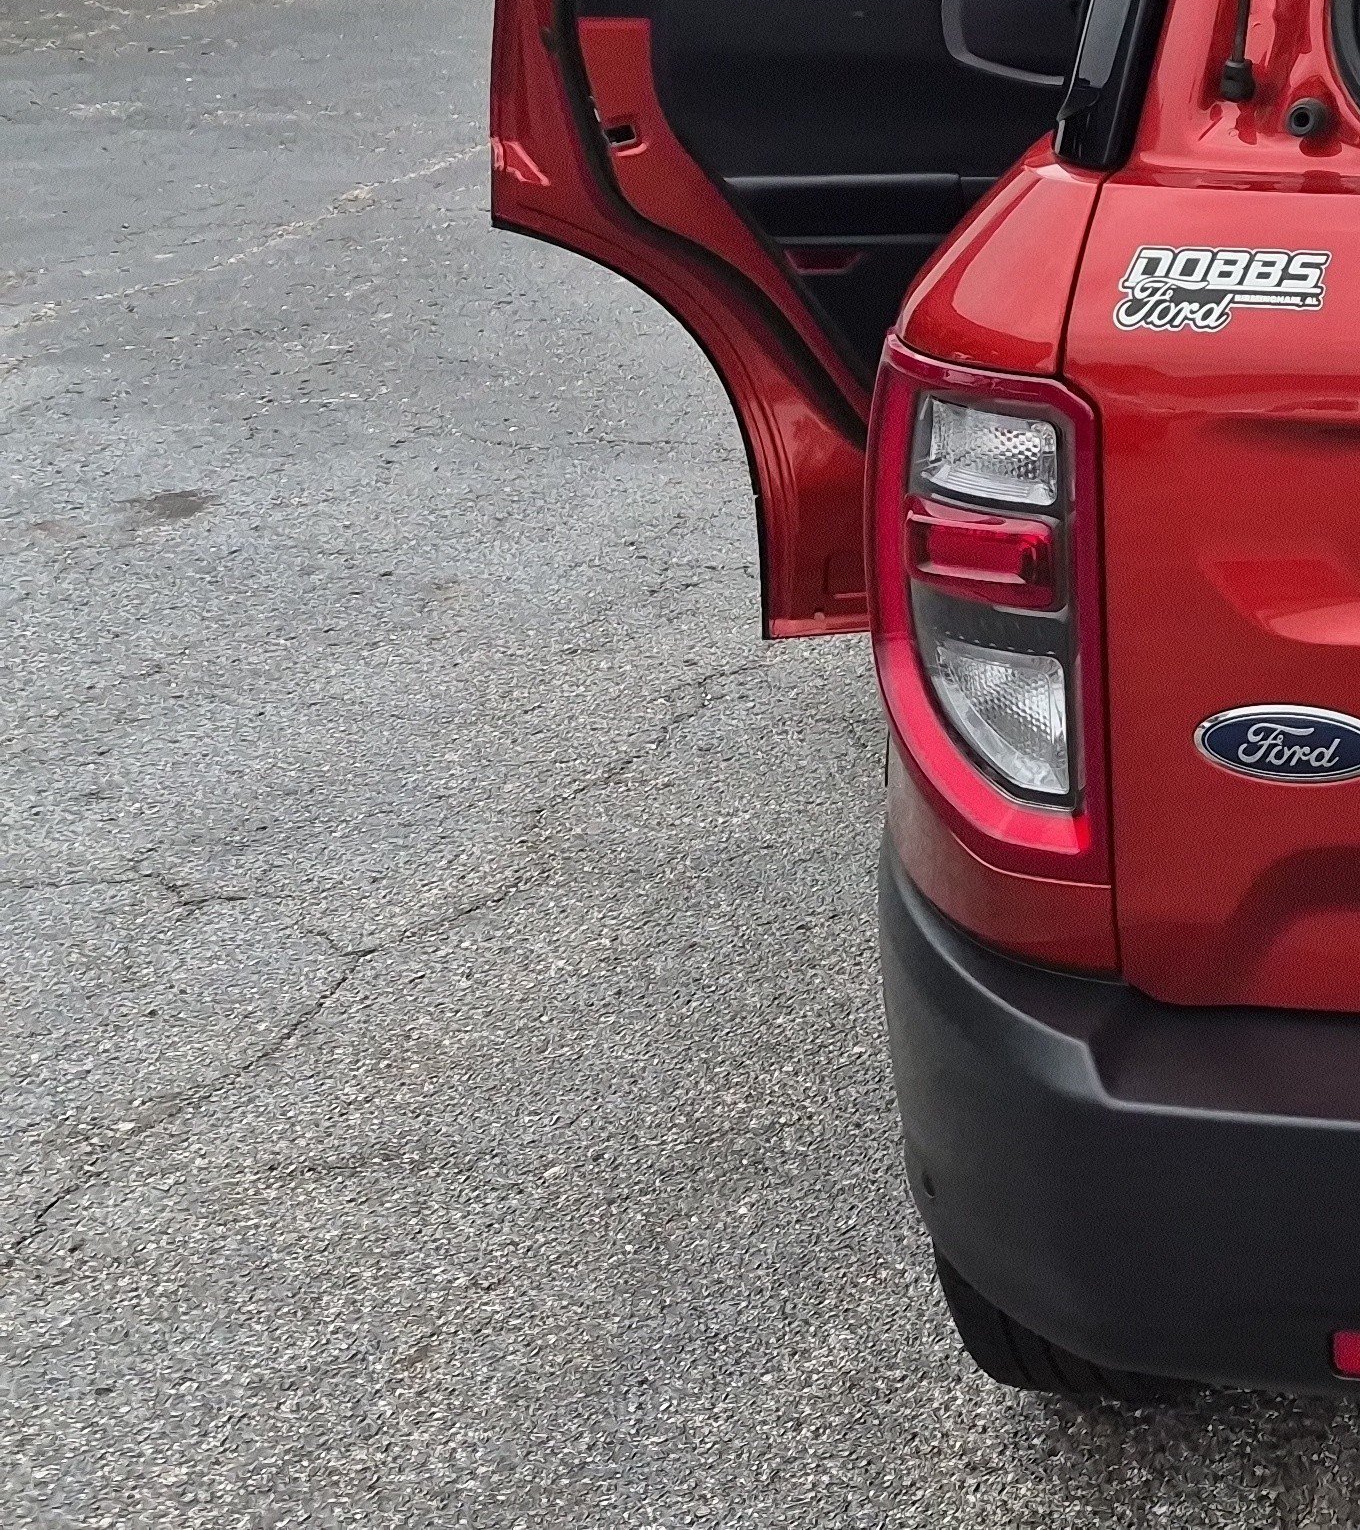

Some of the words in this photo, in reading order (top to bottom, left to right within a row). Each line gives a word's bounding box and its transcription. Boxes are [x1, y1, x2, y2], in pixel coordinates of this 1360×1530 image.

[1126, 249, 1329, 288] DOBBS
[1118, 276, 1230, 328] Ford
[1237, 722, 1341, 768] Ford
